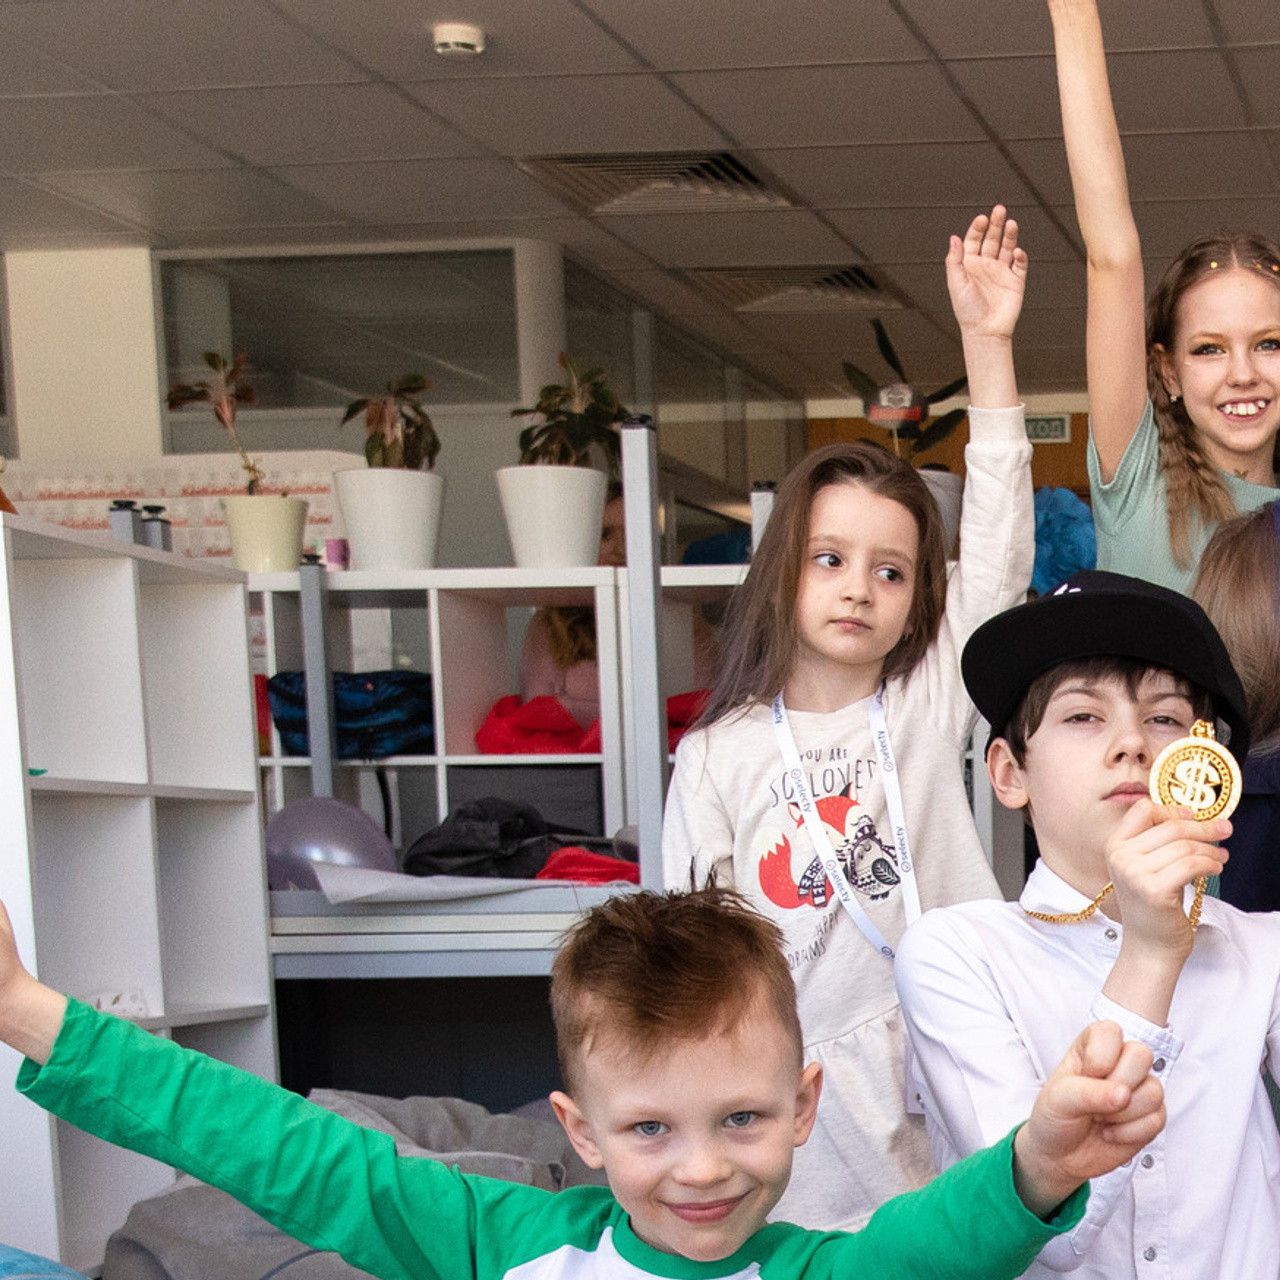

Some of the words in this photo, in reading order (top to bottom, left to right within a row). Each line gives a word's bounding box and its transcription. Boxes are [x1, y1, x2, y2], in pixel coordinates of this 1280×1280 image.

[829, 748, 848, 761] ARE
[795, 778, 811, 812] selecty
[896, 826, 909, 861] selecty
[831, 870, 851, 902] selecty
